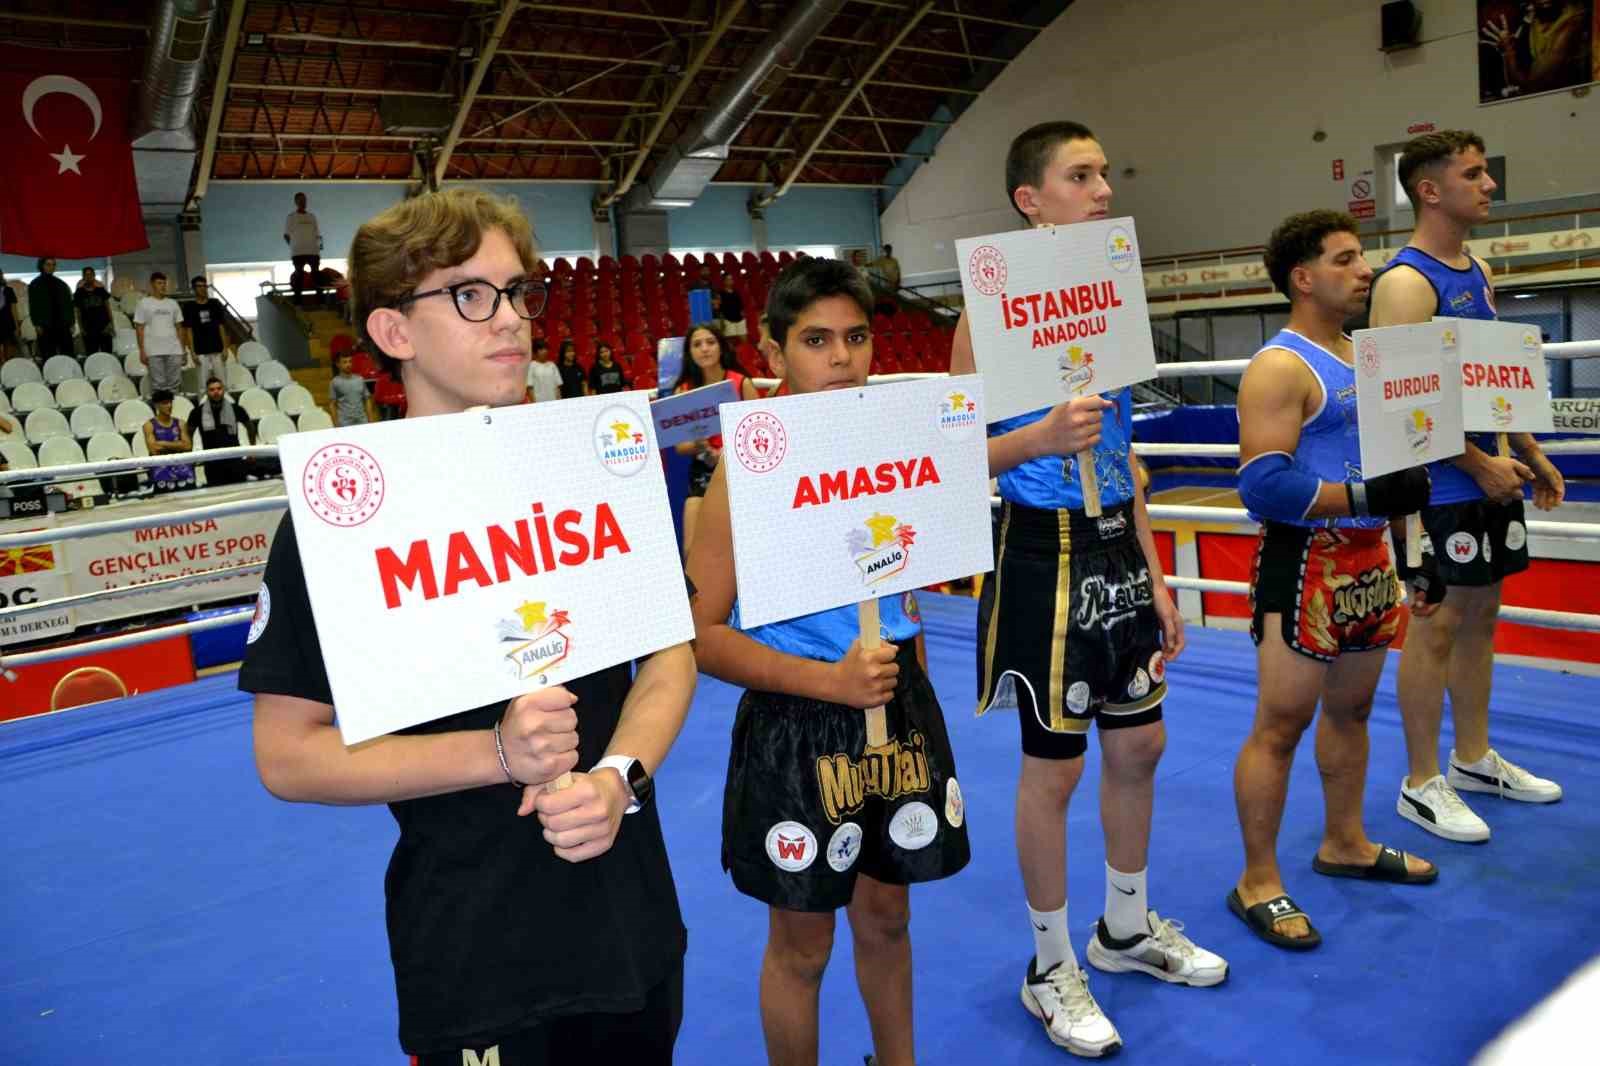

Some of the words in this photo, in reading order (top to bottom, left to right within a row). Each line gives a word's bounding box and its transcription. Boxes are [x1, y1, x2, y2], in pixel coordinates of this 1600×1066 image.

[1001, 281, 1122, 330] İSTANBUL
[1032, 315, 1107, 349] ANADOLU
[1383, 373, 1441, 401] BURDUR
[604, 445, 647, 459] ANADOLU
[792, 455, 941, 509] AMASYA
[13, 500, 41, 511] POSS
[89, 547, 180, 577] GENÇLİK
[184, 543, 209, 561] VE
[214, 533, 267, 556] SPOR
[374, 502, 632, 610] MANİSA
[522, 640, 564, 664] ANALİG
